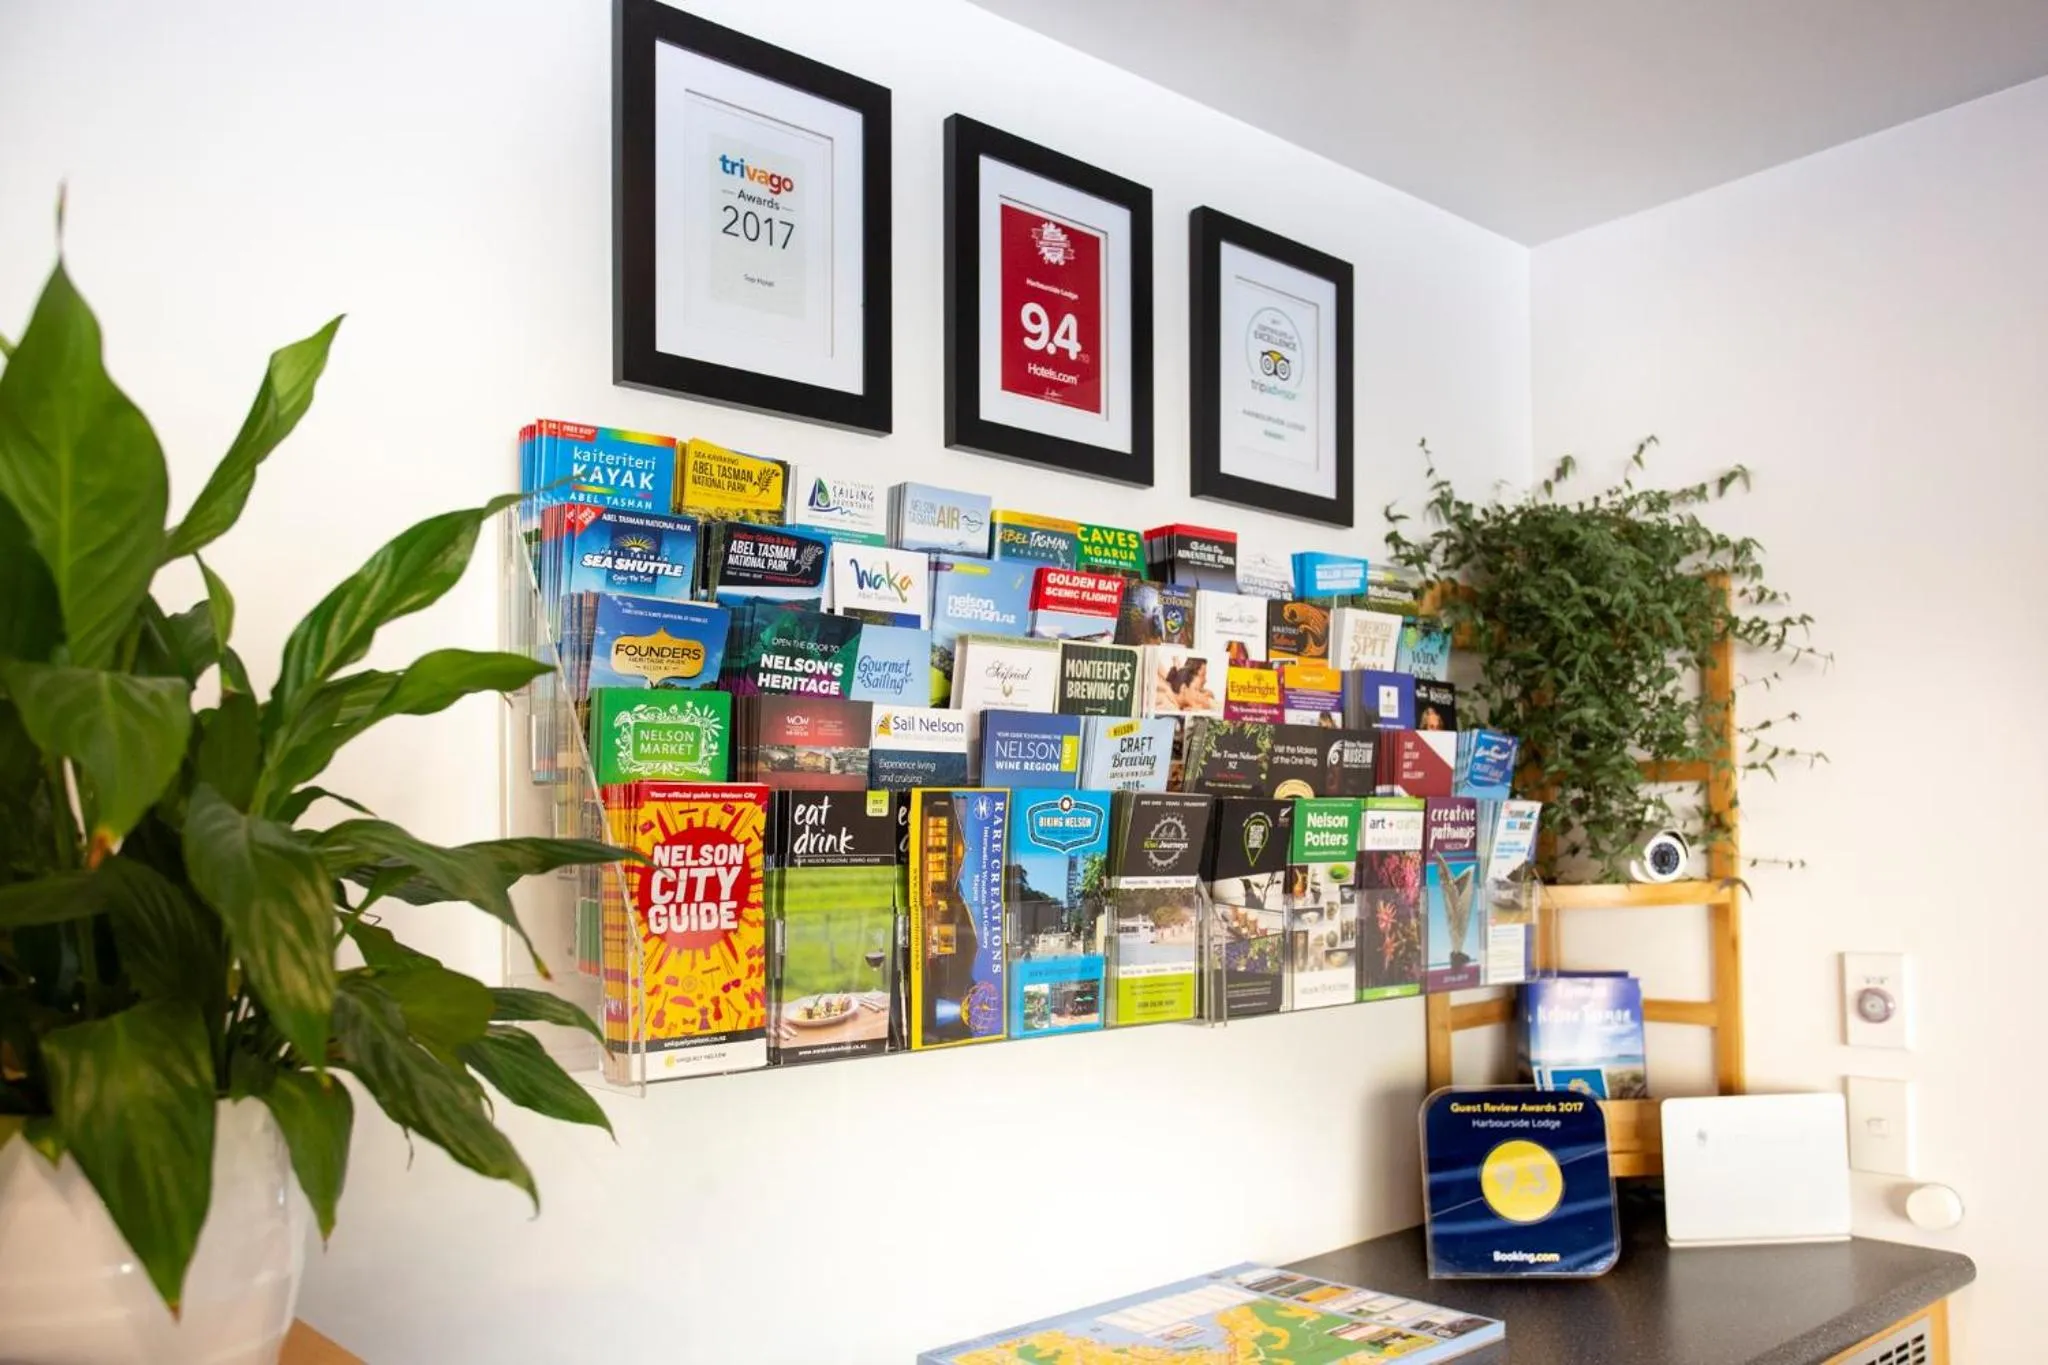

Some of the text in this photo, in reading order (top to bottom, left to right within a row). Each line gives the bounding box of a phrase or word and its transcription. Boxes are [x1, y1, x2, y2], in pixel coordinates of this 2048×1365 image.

[719, 154, 794, 195] trivago
[738, 189, 780, 210] Awards
[722, 205, 794, 249] 2017
[1020, 302, 1082, 361] 9.4
[1027, 363, 1079, 386] Hotels.com
[573, 445, 657, 471] kaiteriteri
[572, 463, 655, 491] KAYAK
[692, 459, 754, 483] ABEL TASMAN
[691, 474, 747, 493] NATIONAL PARK
[569, 491, 653, 510] ABEL TASMAN
[832, 484, 874, 503] SAILING
[601, 512, 692, 532] ABEL TASMAN NATIONAL PARK
[936, 504, 960, 531] AIR
[1029, 530, 1070, 551] TASMAN
[1076, 526, 1139, 549] CAVES
[729, 540, 798, 561] ABEL TASMAN
[1083, 545, 1137, 562] NGARUA
[581, 553, 685, 577] SEA SHUTTLE
[727, 553, 790, 572] NATIONAL PARK
[849, 557, 915, 604] Waka
[1047, 572, 1122, 592] GOLDEN BAY
[948, 592, 995, 611] nelson
[1044, 586, 1119, 604] SCENIC FLIGHTS
[615, 644, 702, 661] FOUNDERS
[771, 637, 792, 648] OPEN
[792, 639, 806, 650] THE
[806, 642, 829, 653] DOOR
[1350, 635, 1387, 658] SPIT
[759, 653, 844, 678] NELSON'S
[857, 654, 912, 678] Gourmet
[1065, 658, 1133, 681] MONTEITH'S
[757, 672, 841, 696] HERITAGE
[864, 672, 906, 696] Sailing
[1066, 680, 1116, 700] BREWING
[1229, 680, 1277, 699] Eyebright
[786, 715, 809, 726] WOW
[893, 715, 964, 734] Sail Nelson
[639, 729, 695, 742] NELSON
[1119, 736, 1154, 754] CRAFT
[639, 743, 694, 755] MARKET
[994, 740, 1062, 760] NELSON
[1286, 745, 1296, 753] the
[878, 758, 917, 772] Experience
[995, 760, 1060, 773] WINE REGION
[1111, 753, 1157, 770] Brewing
[1272, 756, 1318, 767] of the One Ring
[878, 772, 923, 785] and cruising
[667, 791, 692, 799] official
[692, 792, 712, 800] guide
[744, 792, 757, 800] City
[793, 795, 833, 826] eat
[1307, 811, 1349, 829] Nelson
[1430, 804, 1476, 823] creative
[1064, 816, 1092, 828] NELSON
[1369, 816, 1386, 830] art
[792, 824, 856, 855] drink
[1143, 840, 1189, 851] Kiwi Journeys
[1304, 830, 1349, 847] Potters
[1429, 825, 1476, 850] pathways
[653, 843, 745, 868] NELSON
[650, 866, 743, 905] CITY
[989, 801, 1005, 974] RARE CREATIONS
[648, 901, 738, 935] GUIDE
[1450, 1101, 1584, 1113] Guest Review Awards 2017
[1471, 1118, 1562, 1131] Harbourside Lodge
[1492, 1250, 1561, 1264] Booking.com
